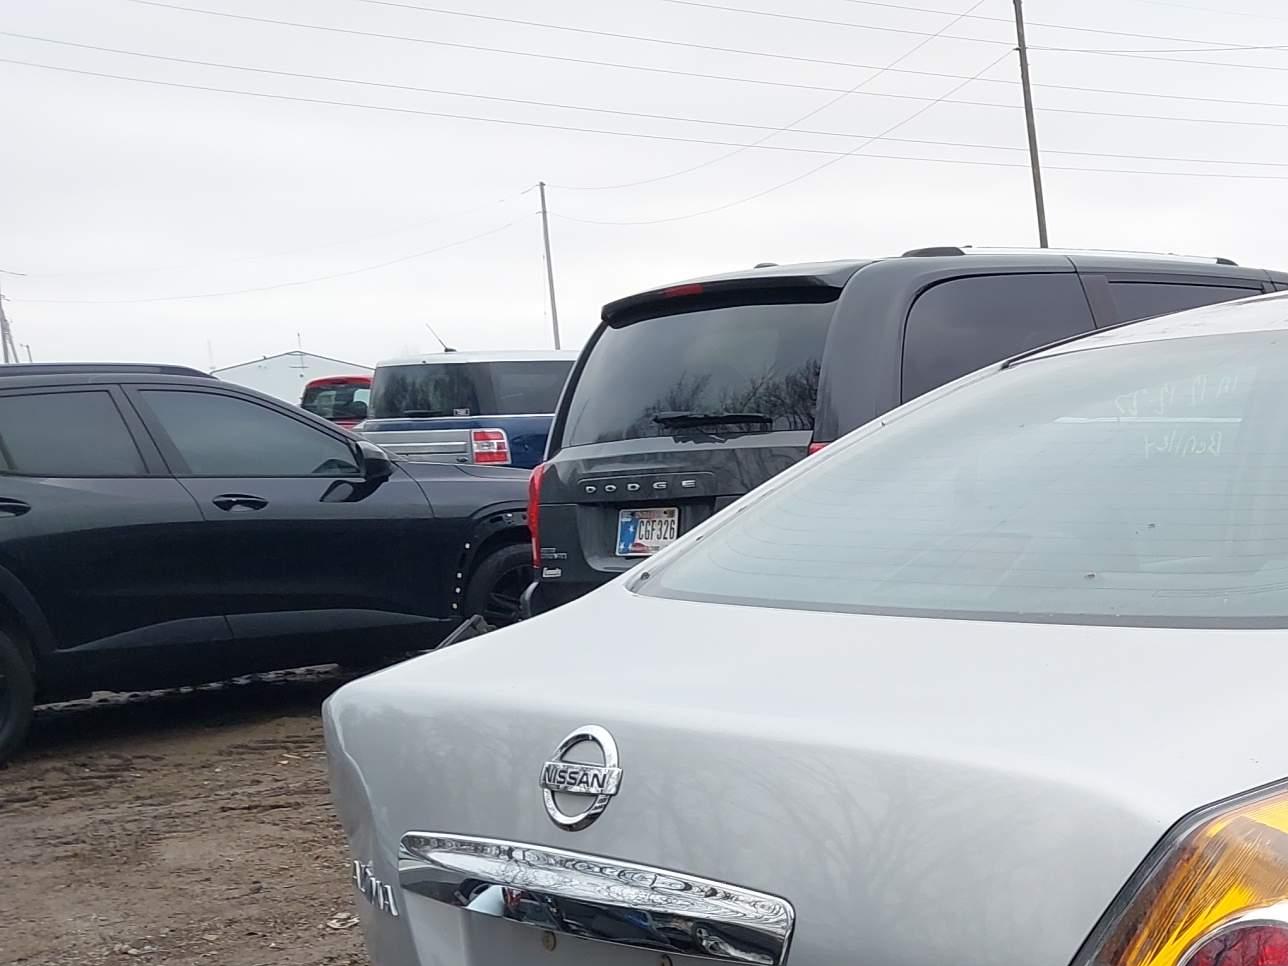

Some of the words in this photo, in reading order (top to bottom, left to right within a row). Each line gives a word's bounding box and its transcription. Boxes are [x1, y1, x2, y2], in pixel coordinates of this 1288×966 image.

[585, 479, 696, 494] DODGE
[639, 519, 676, 541] CGF326
[544, 766, 607, 789] NISSAN
